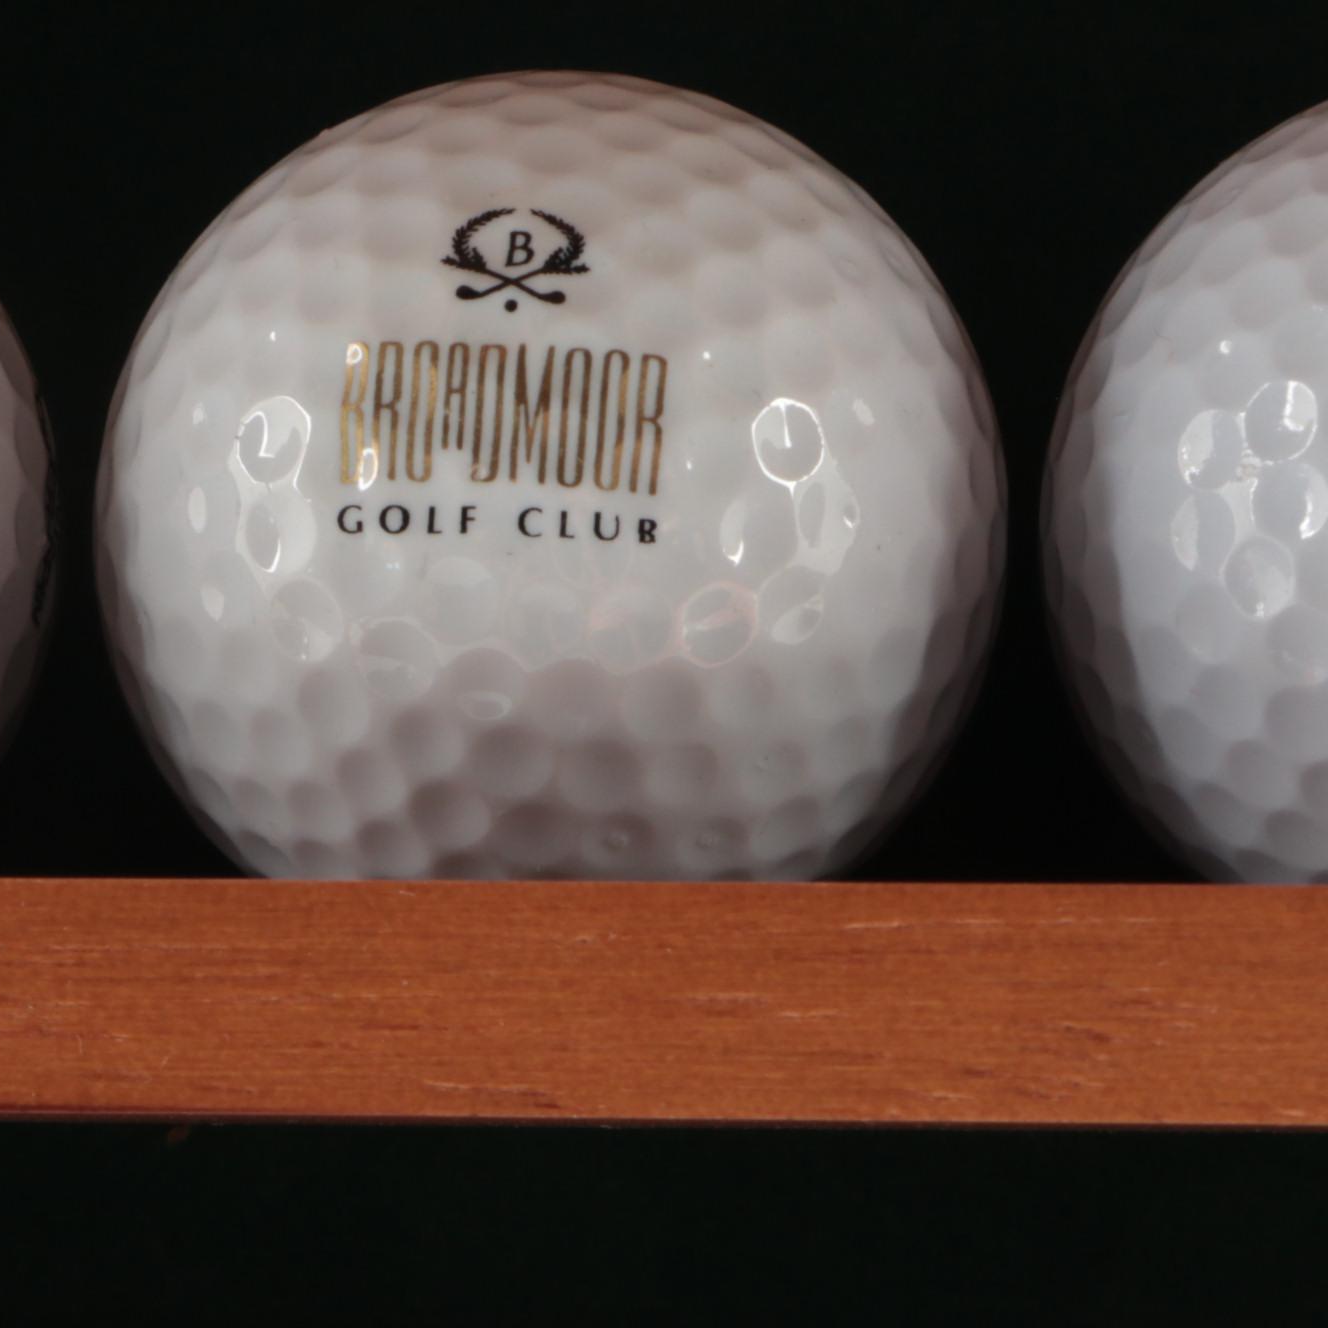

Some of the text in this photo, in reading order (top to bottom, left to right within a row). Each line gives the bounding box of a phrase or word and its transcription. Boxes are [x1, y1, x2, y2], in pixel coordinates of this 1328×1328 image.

[505, 230, 535, 267] B
[339, 340, 668, 496] BROADMOOR
[337, 505, 658, 544] GOLF CLUB
